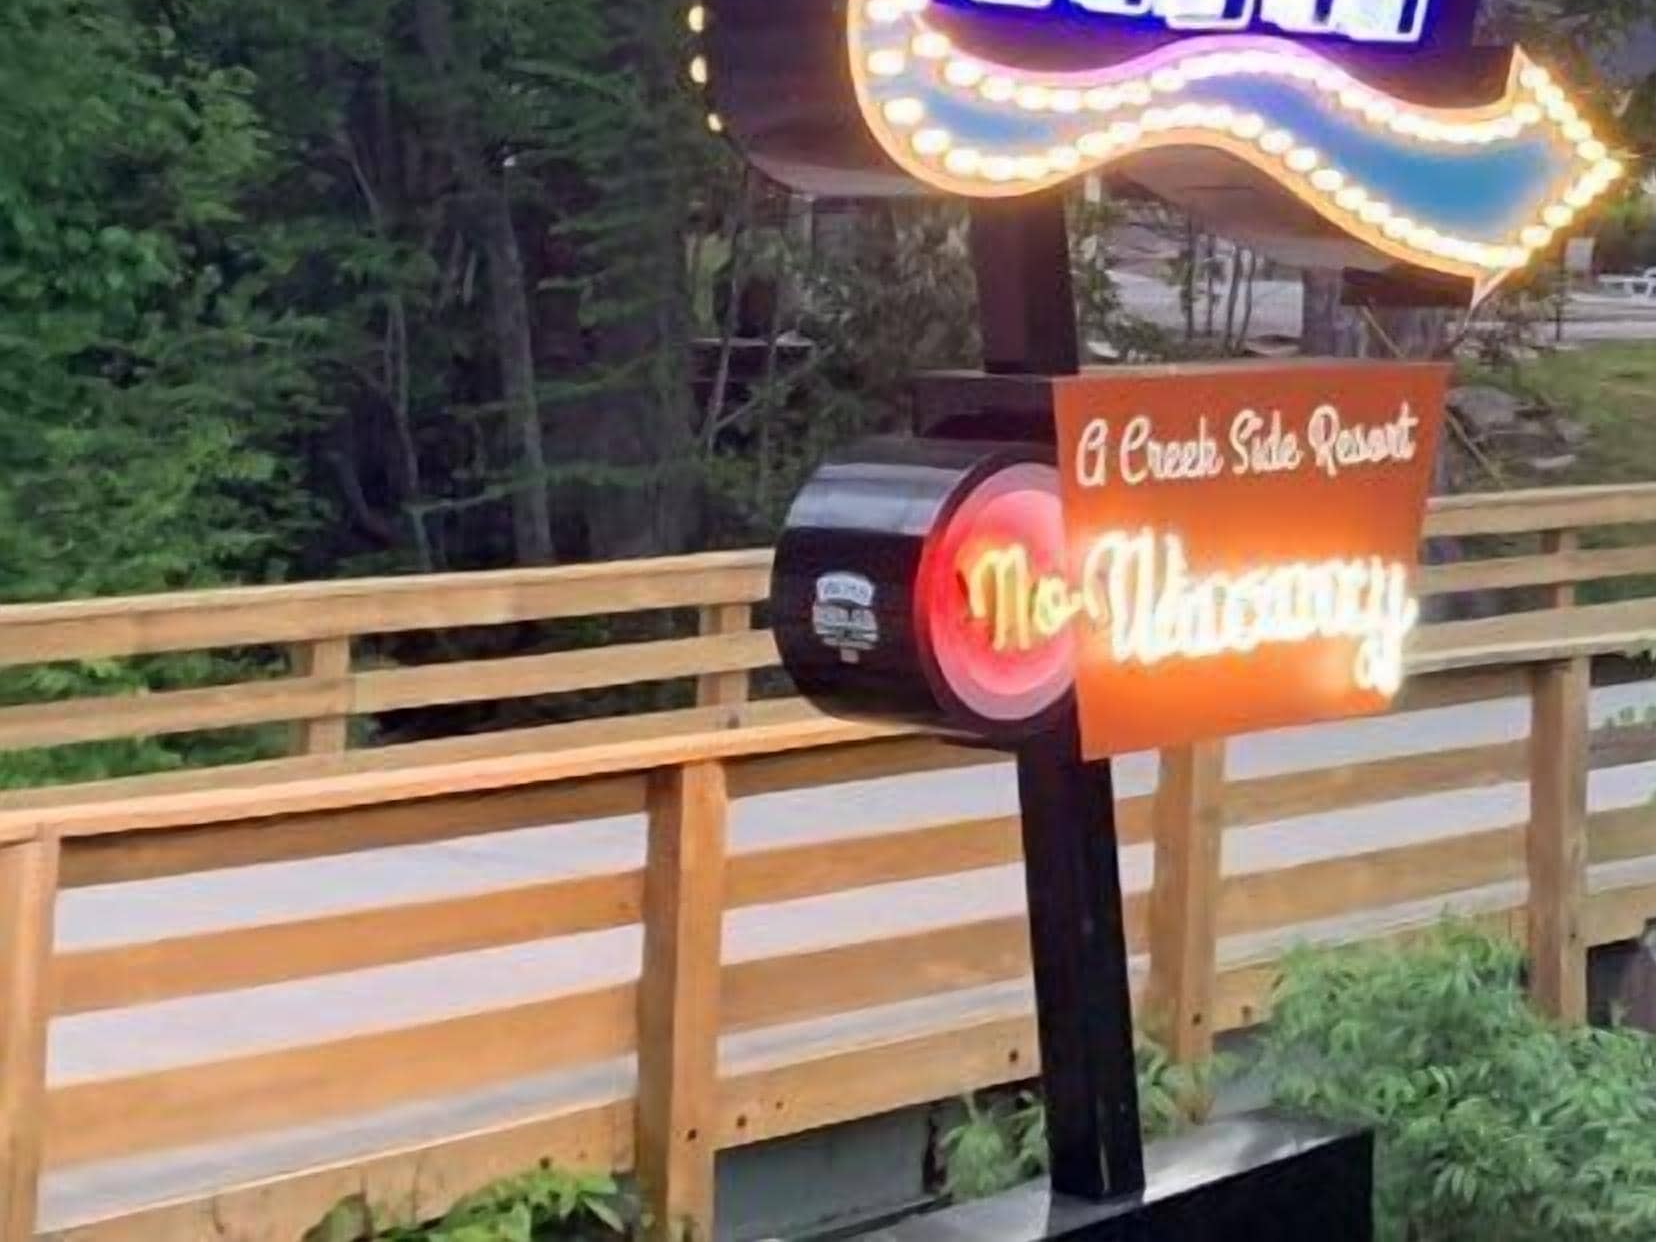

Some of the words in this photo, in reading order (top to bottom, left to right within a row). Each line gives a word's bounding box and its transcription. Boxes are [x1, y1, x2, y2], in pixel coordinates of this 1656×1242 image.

[1119, 414, 1225, 485] Creek
[1229, 408, 1302, 474] Side
[1306, 400, 1419, 477] Resort
[965, 543, 1082, 652] No
[1084, 525, 1420, 696] Vacancy
